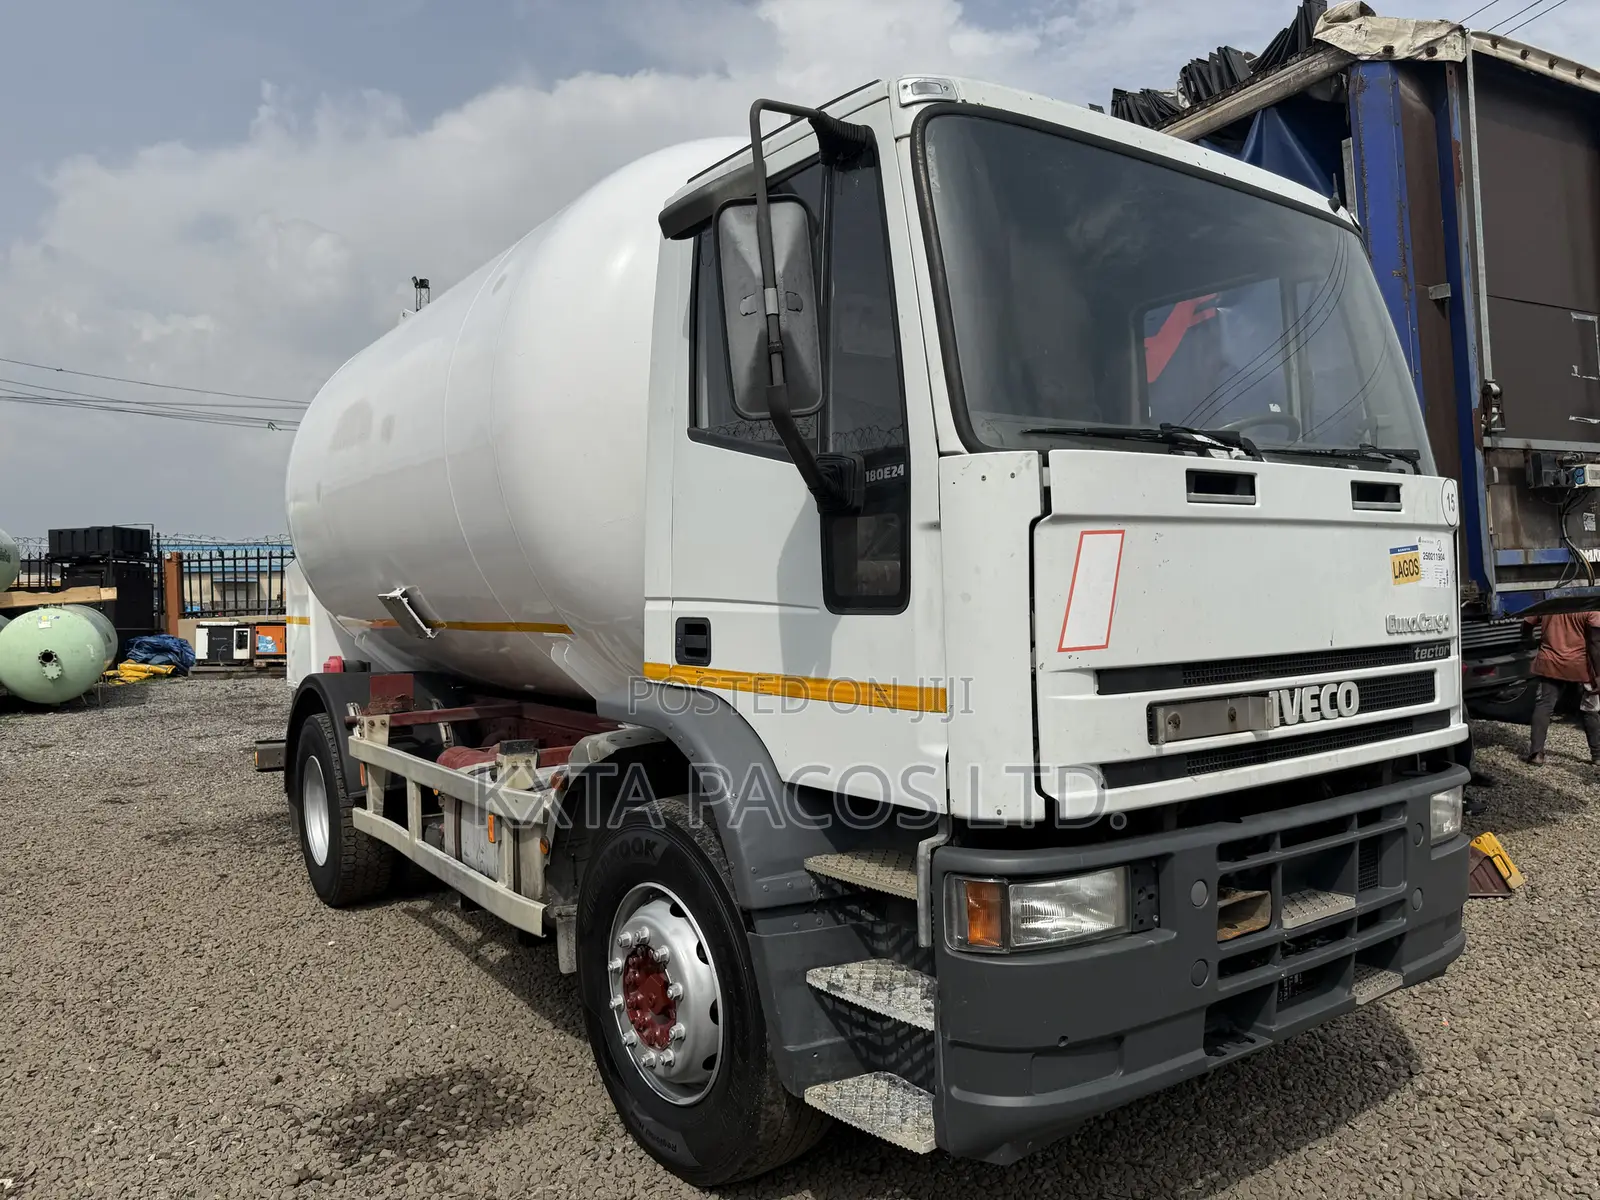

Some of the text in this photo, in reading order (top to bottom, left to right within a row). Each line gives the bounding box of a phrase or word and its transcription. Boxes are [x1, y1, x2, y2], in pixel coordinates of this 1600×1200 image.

[865, 463, 904, 483] 180E24
[1447, 493, 1455, 512] 15
[1392, 558, 1420, 579] LAGOS
[1385, 612, 1451, 636] EuroCargo
[1414, 644, 1450, 661] tector
[1268, 680, 1360, 728] IVECO
